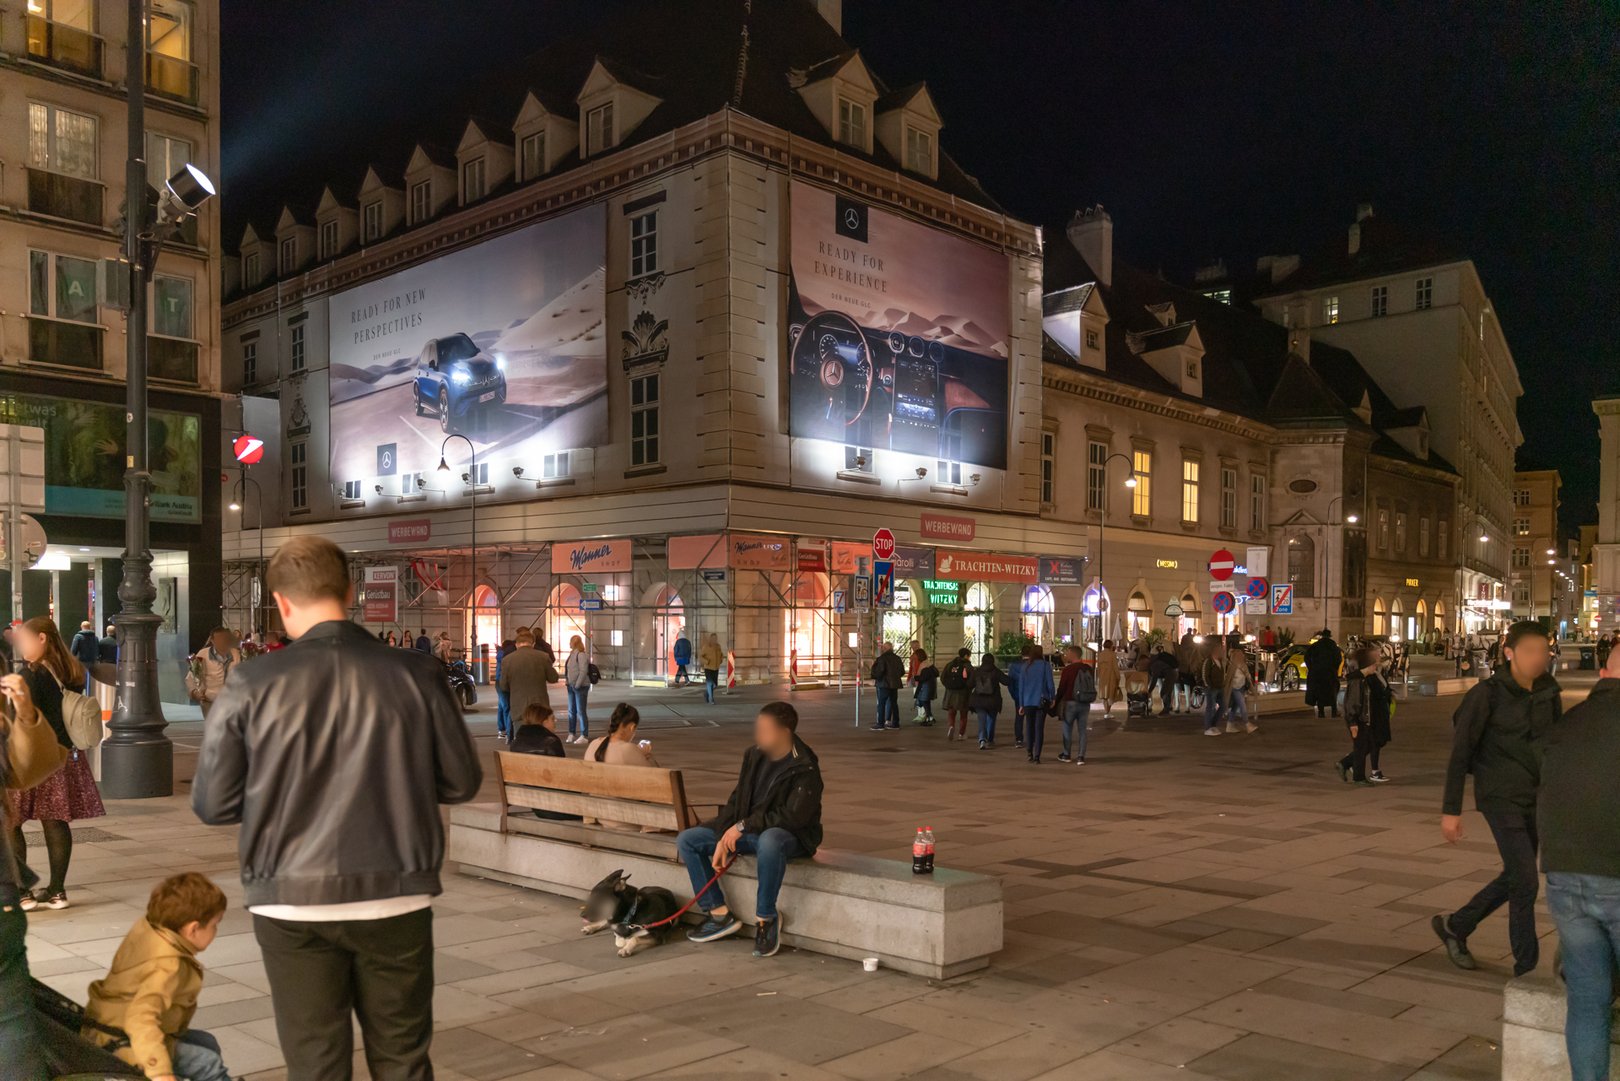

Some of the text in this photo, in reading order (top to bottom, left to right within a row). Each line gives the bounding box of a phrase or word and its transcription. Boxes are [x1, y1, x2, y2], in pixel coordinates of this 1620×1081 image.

[819, 240, 884, 272] READY FOR
[814, 260, 887, 293] EXPERIENCE
[68, 281, 85, 297] A
[167, 297, 179, 312] T
[351, 288, 426, 324] READY FOR NEW
[845, 296, 859, 306] NEUE
[354, 312, 423, 345] PERSPECTIVES
[391, 525, 428, 538] WERBEWAND
[925, 520, 971, 536] WERBEWAND
[876, 539, 893, 550] STOP
[570, 544, 612, 570] Manner
[955, 560, 1036, 576] TRACHTEN-WITZKY
[366, 589, 391, 599] Gerüstbau
[930, 594, 958, 605] WITZKY
